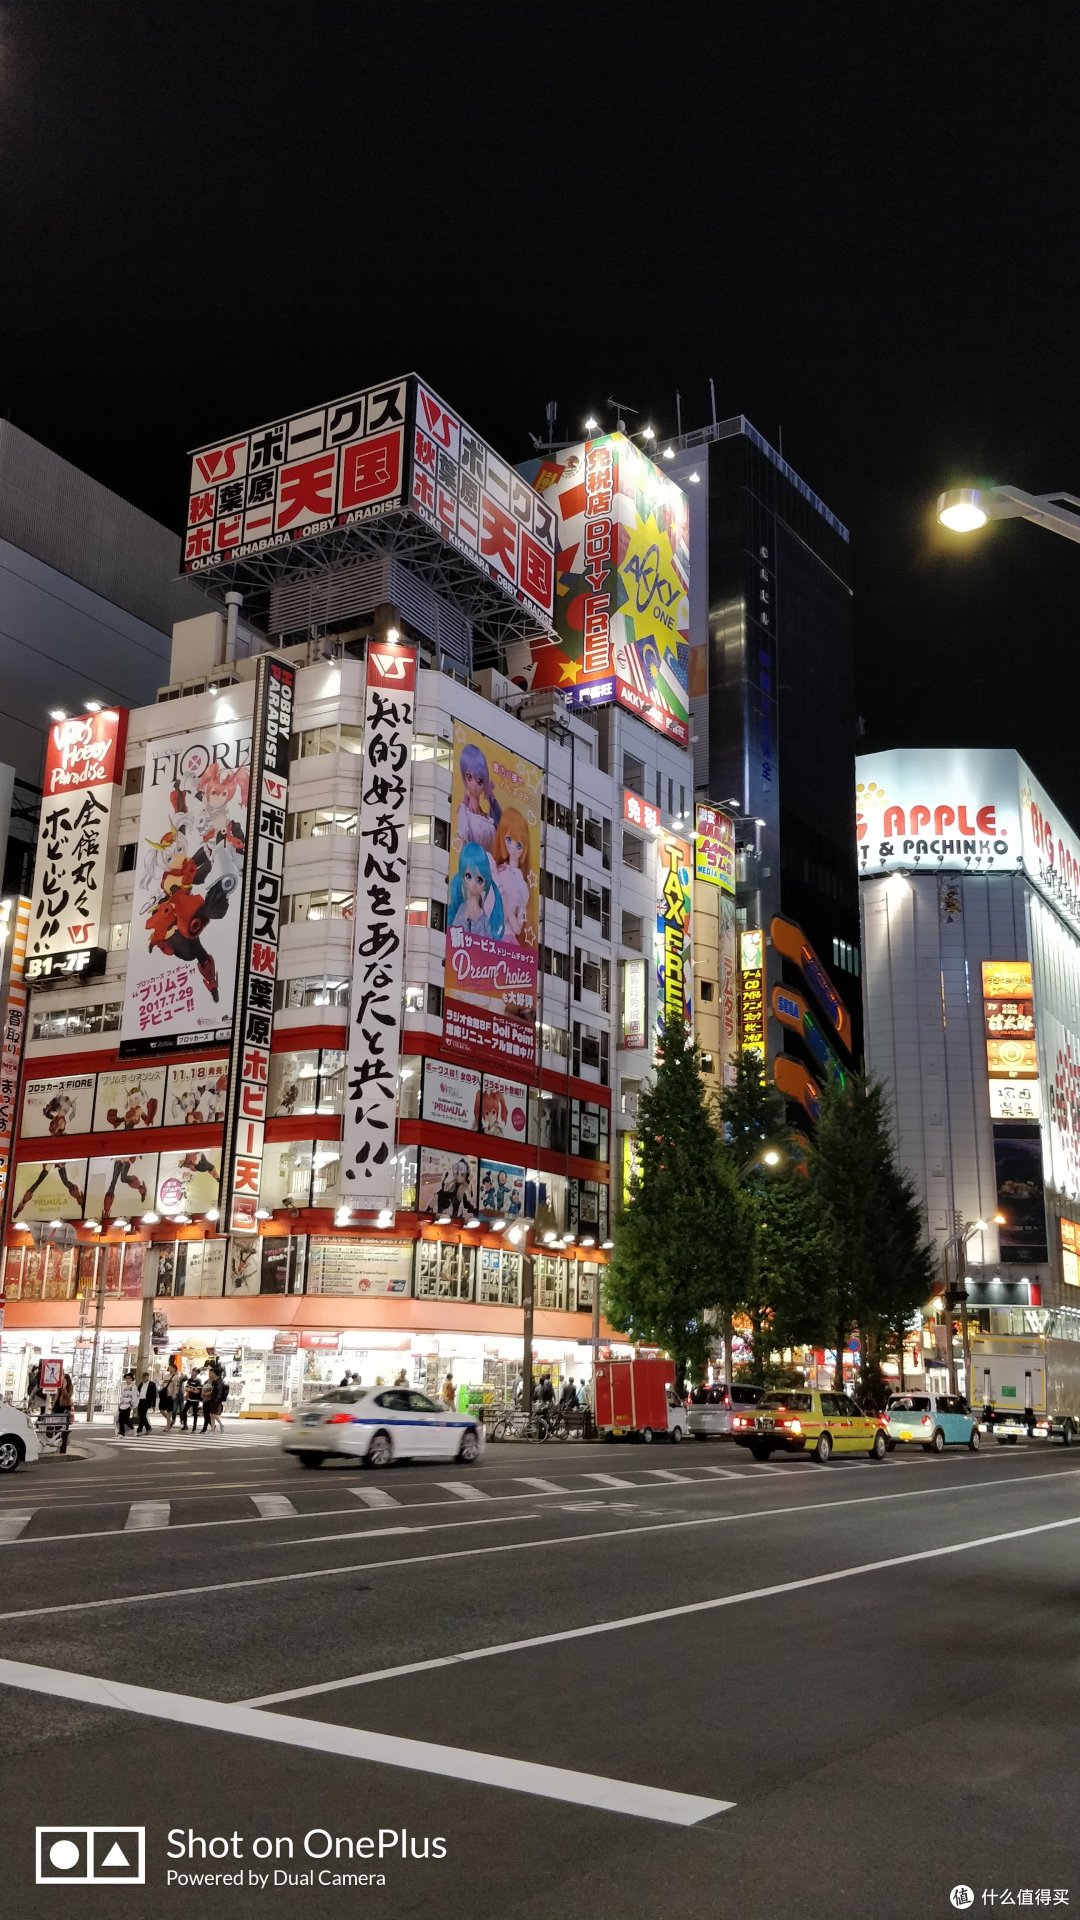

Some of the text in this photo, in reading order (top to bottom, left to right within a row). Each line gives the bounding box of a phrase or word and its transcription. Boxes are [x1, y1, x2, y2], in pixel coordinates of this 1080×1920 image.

[250, 386, 404, 471] ボークス
[277, 431, 401, 529] 天国
[415, 431, 479, 515] 秋葉原
[585, 445, 613, 518] 免税店
[189, 475, 275, 524] 秋葉原
[413, 472, 477, 538] ホビー
[461, 437, 554, 549] ボークス
[184, 499, 401, 573] VOLKS AKIHABARA HOBBY PARADISE
[185, 516, 272, 559] ホビー
[480, 493, 553, 609] 天国
[413, 502, 554, 626] VOLKS AKIHABARA HOBBY PARADISE
[585, 519, 612, 592] DUTY
[584, 594, 611, 674] FREE
[652, 605, 675, 631] ONE
[264, 663, 282, 769] PARADISE
[279, 665, 293, 741] HOBBY
[620, 686, 646, 711] AKKY
[50, 759, 108, 793] Paradise
[150, 736, 253, 787] FIORE
[627, 797, 657, 830] 免税
[878, 841, 895, 857] &
[902, 839, 1009, 856] PACHINKO
[1030, 801, 1055, 864] BIG
[663, 843, 685, 928] TAX
[697, 864, 717, 878] MEDIA
[449, 926, 497, 955] 新サービス
[496, 947, 535, 964] ドリームチョイス
[139, 986, 194, 1017] 2017.7.29
[742, 990, 762, 1001] アイドル
[744, 980, 760, 990] CD
[139, 997, 195, 1032] デビュー!!
[742, 1001, 763, 1011] アニメ
[743, 1012, 762, 1021] コミック
[492, 1021, 511, 1039] Doll
[511, 1027, 534, 1047] Point
[744, 1022, 762, 1032] ホビー
[27, 1078, 93, 1093] ブロッカーズ FIORE
[172, 1068, 206, 1081] 11.18
[481, 1251, 500, 1268] 5F
